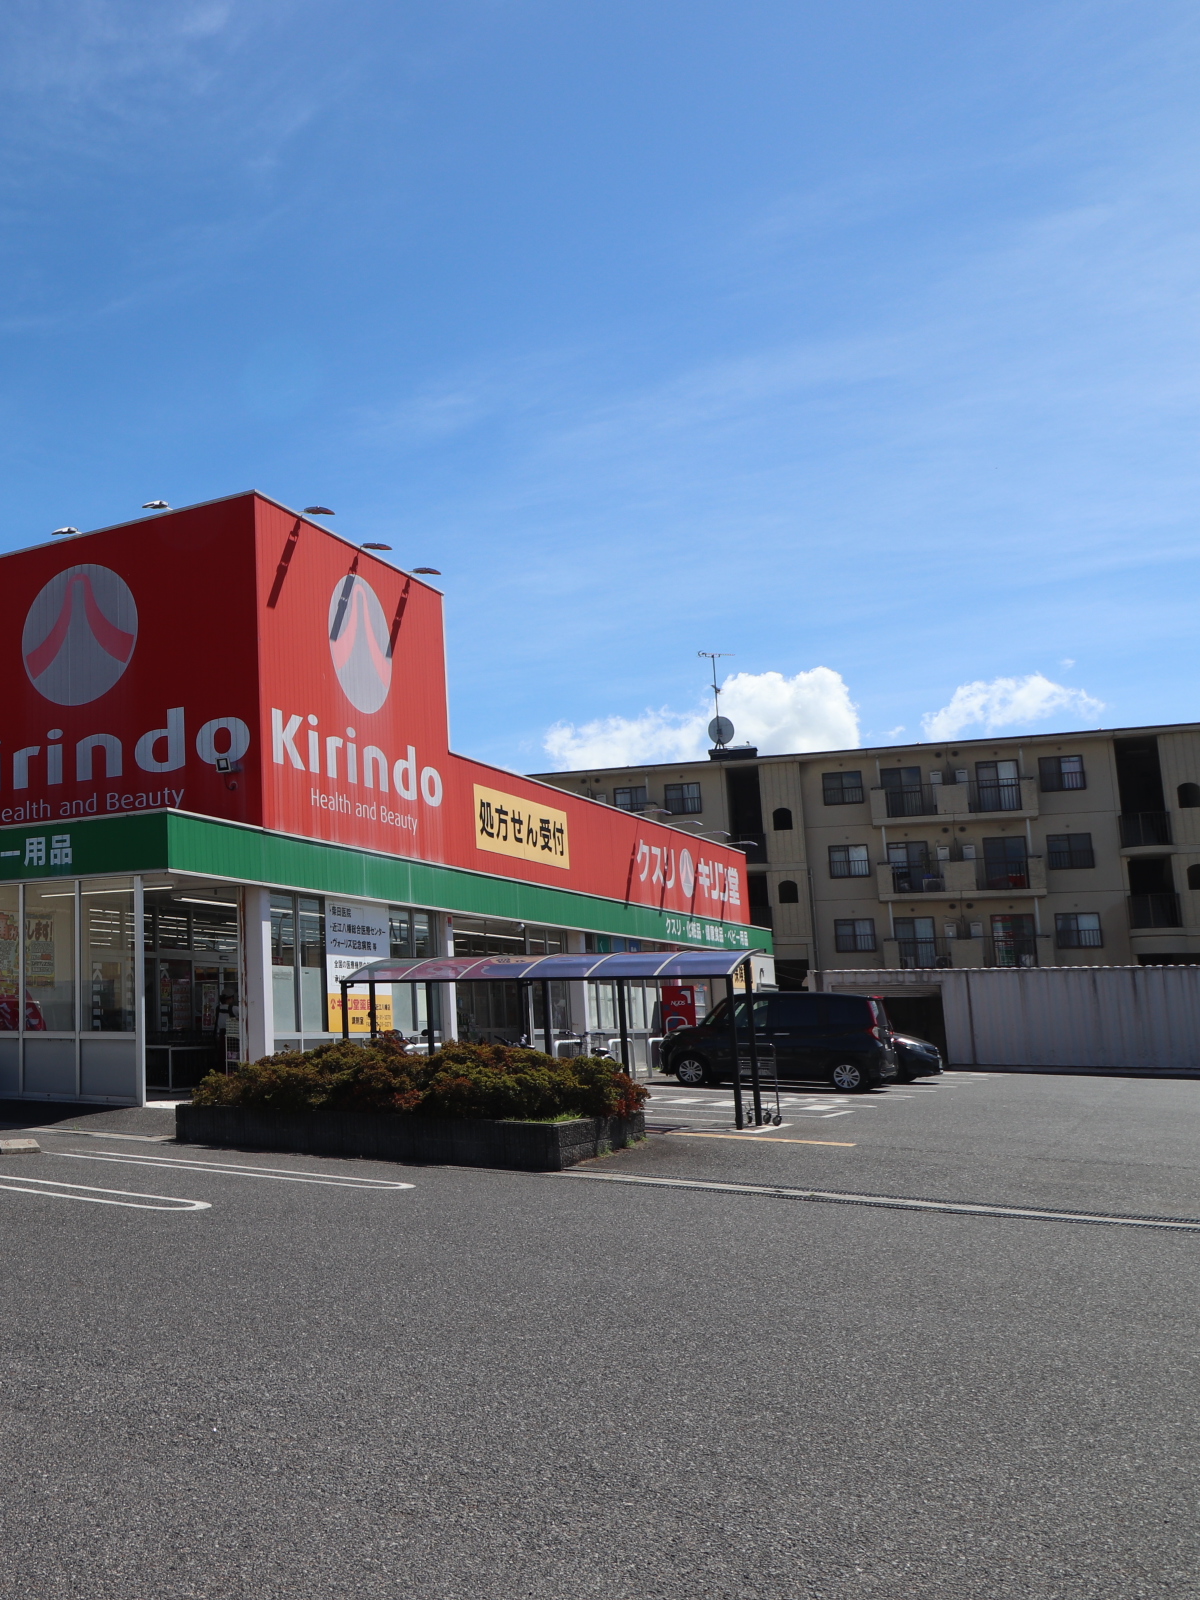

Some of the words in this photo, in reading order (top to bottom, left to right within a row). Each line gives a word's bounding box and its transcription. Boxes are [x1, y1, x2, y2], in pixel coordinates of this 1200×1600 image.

[271, 707, 443, 807] Kirindo
[59, 793, 98, 816] and
[106, 786, 185, 811] Beauty
[311, 787, 351, 815] Health
[355, 800, 377, 821] and
[380, 805, 418, 836] Beauty
[479, 798, 566, 857] 処方せん受付
[637, 839, 676, 888] クスリ
[698, 858, 741, 905] キリン堂
